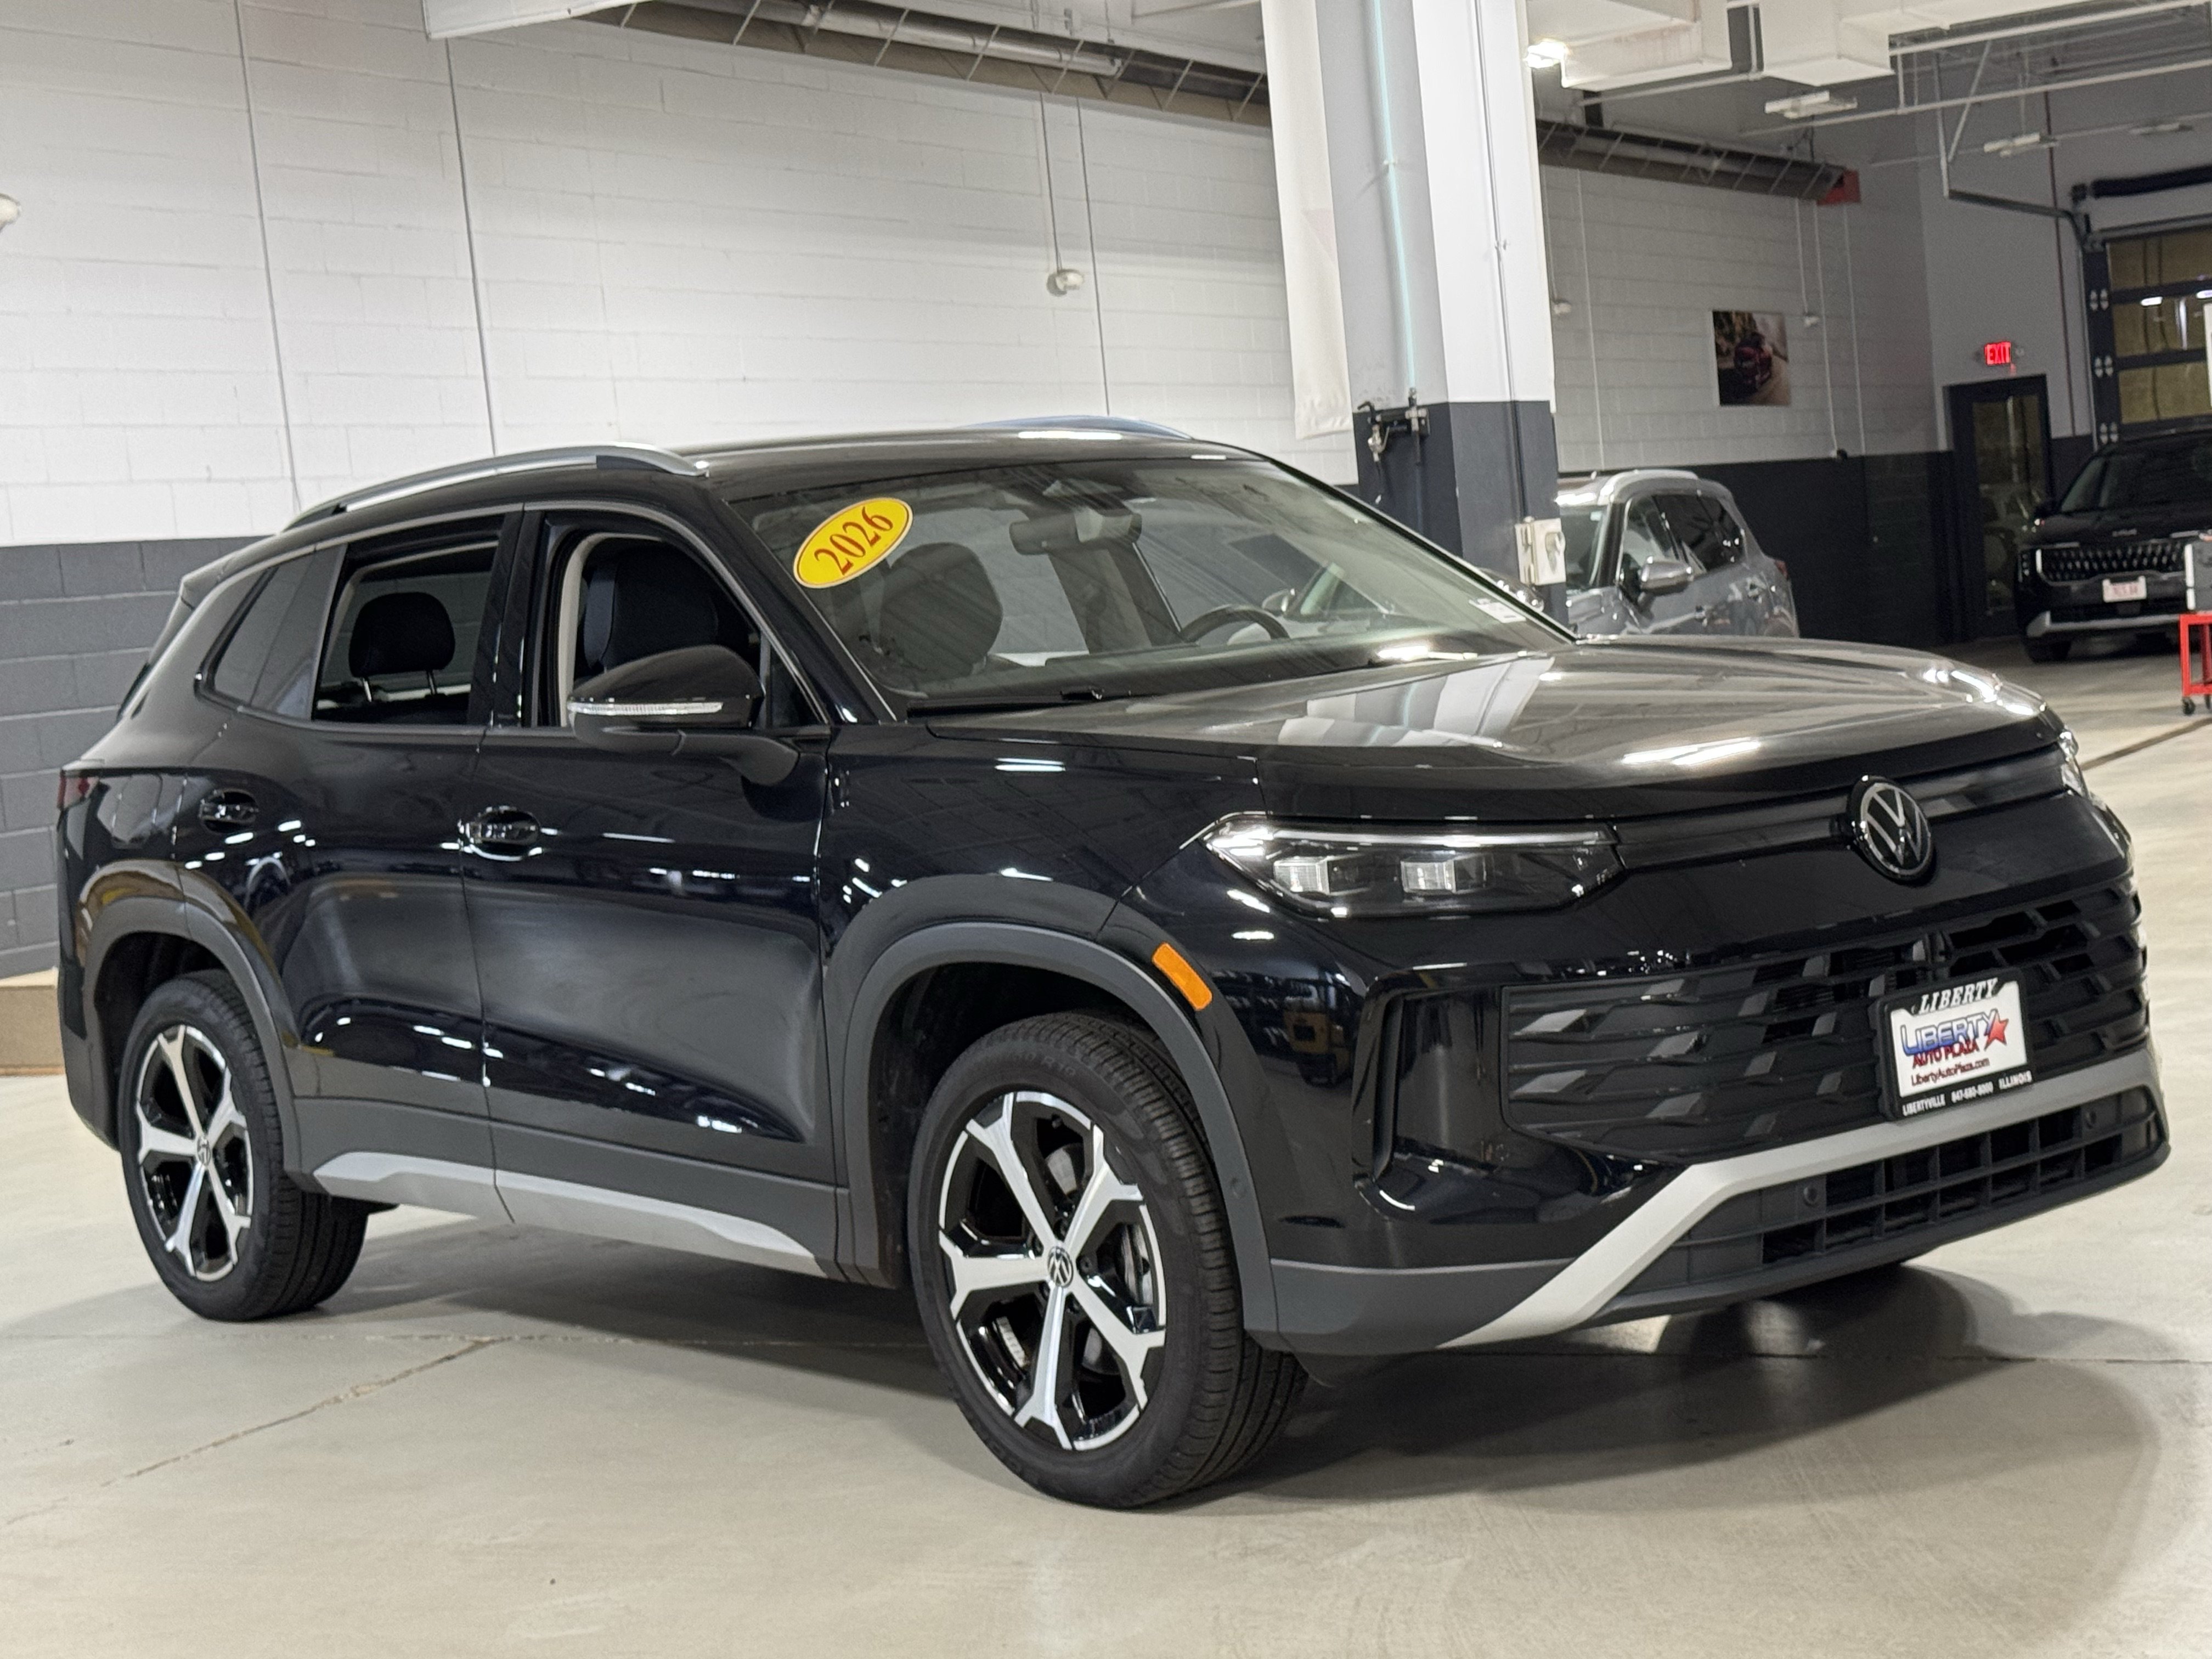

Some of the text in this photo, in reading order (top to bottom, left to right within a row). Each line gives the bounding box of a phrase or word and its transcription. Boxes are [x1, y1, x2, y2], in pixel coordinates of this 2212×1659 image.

[1987, 342, 2011, 365] EXIT
[814, 506, 893, 575] 2026
[1919, 977, 1999, 1014] LIBERTY
[1900, 1008, 1998, 1057] LIBERTY
[1912, 1039, 1980, 1069] AUTO PLAZA
[1902, 1093, 1946, 1116] LIBERTYVILLE
[1998, 1070, 2033, 1090] ILLINOIS
